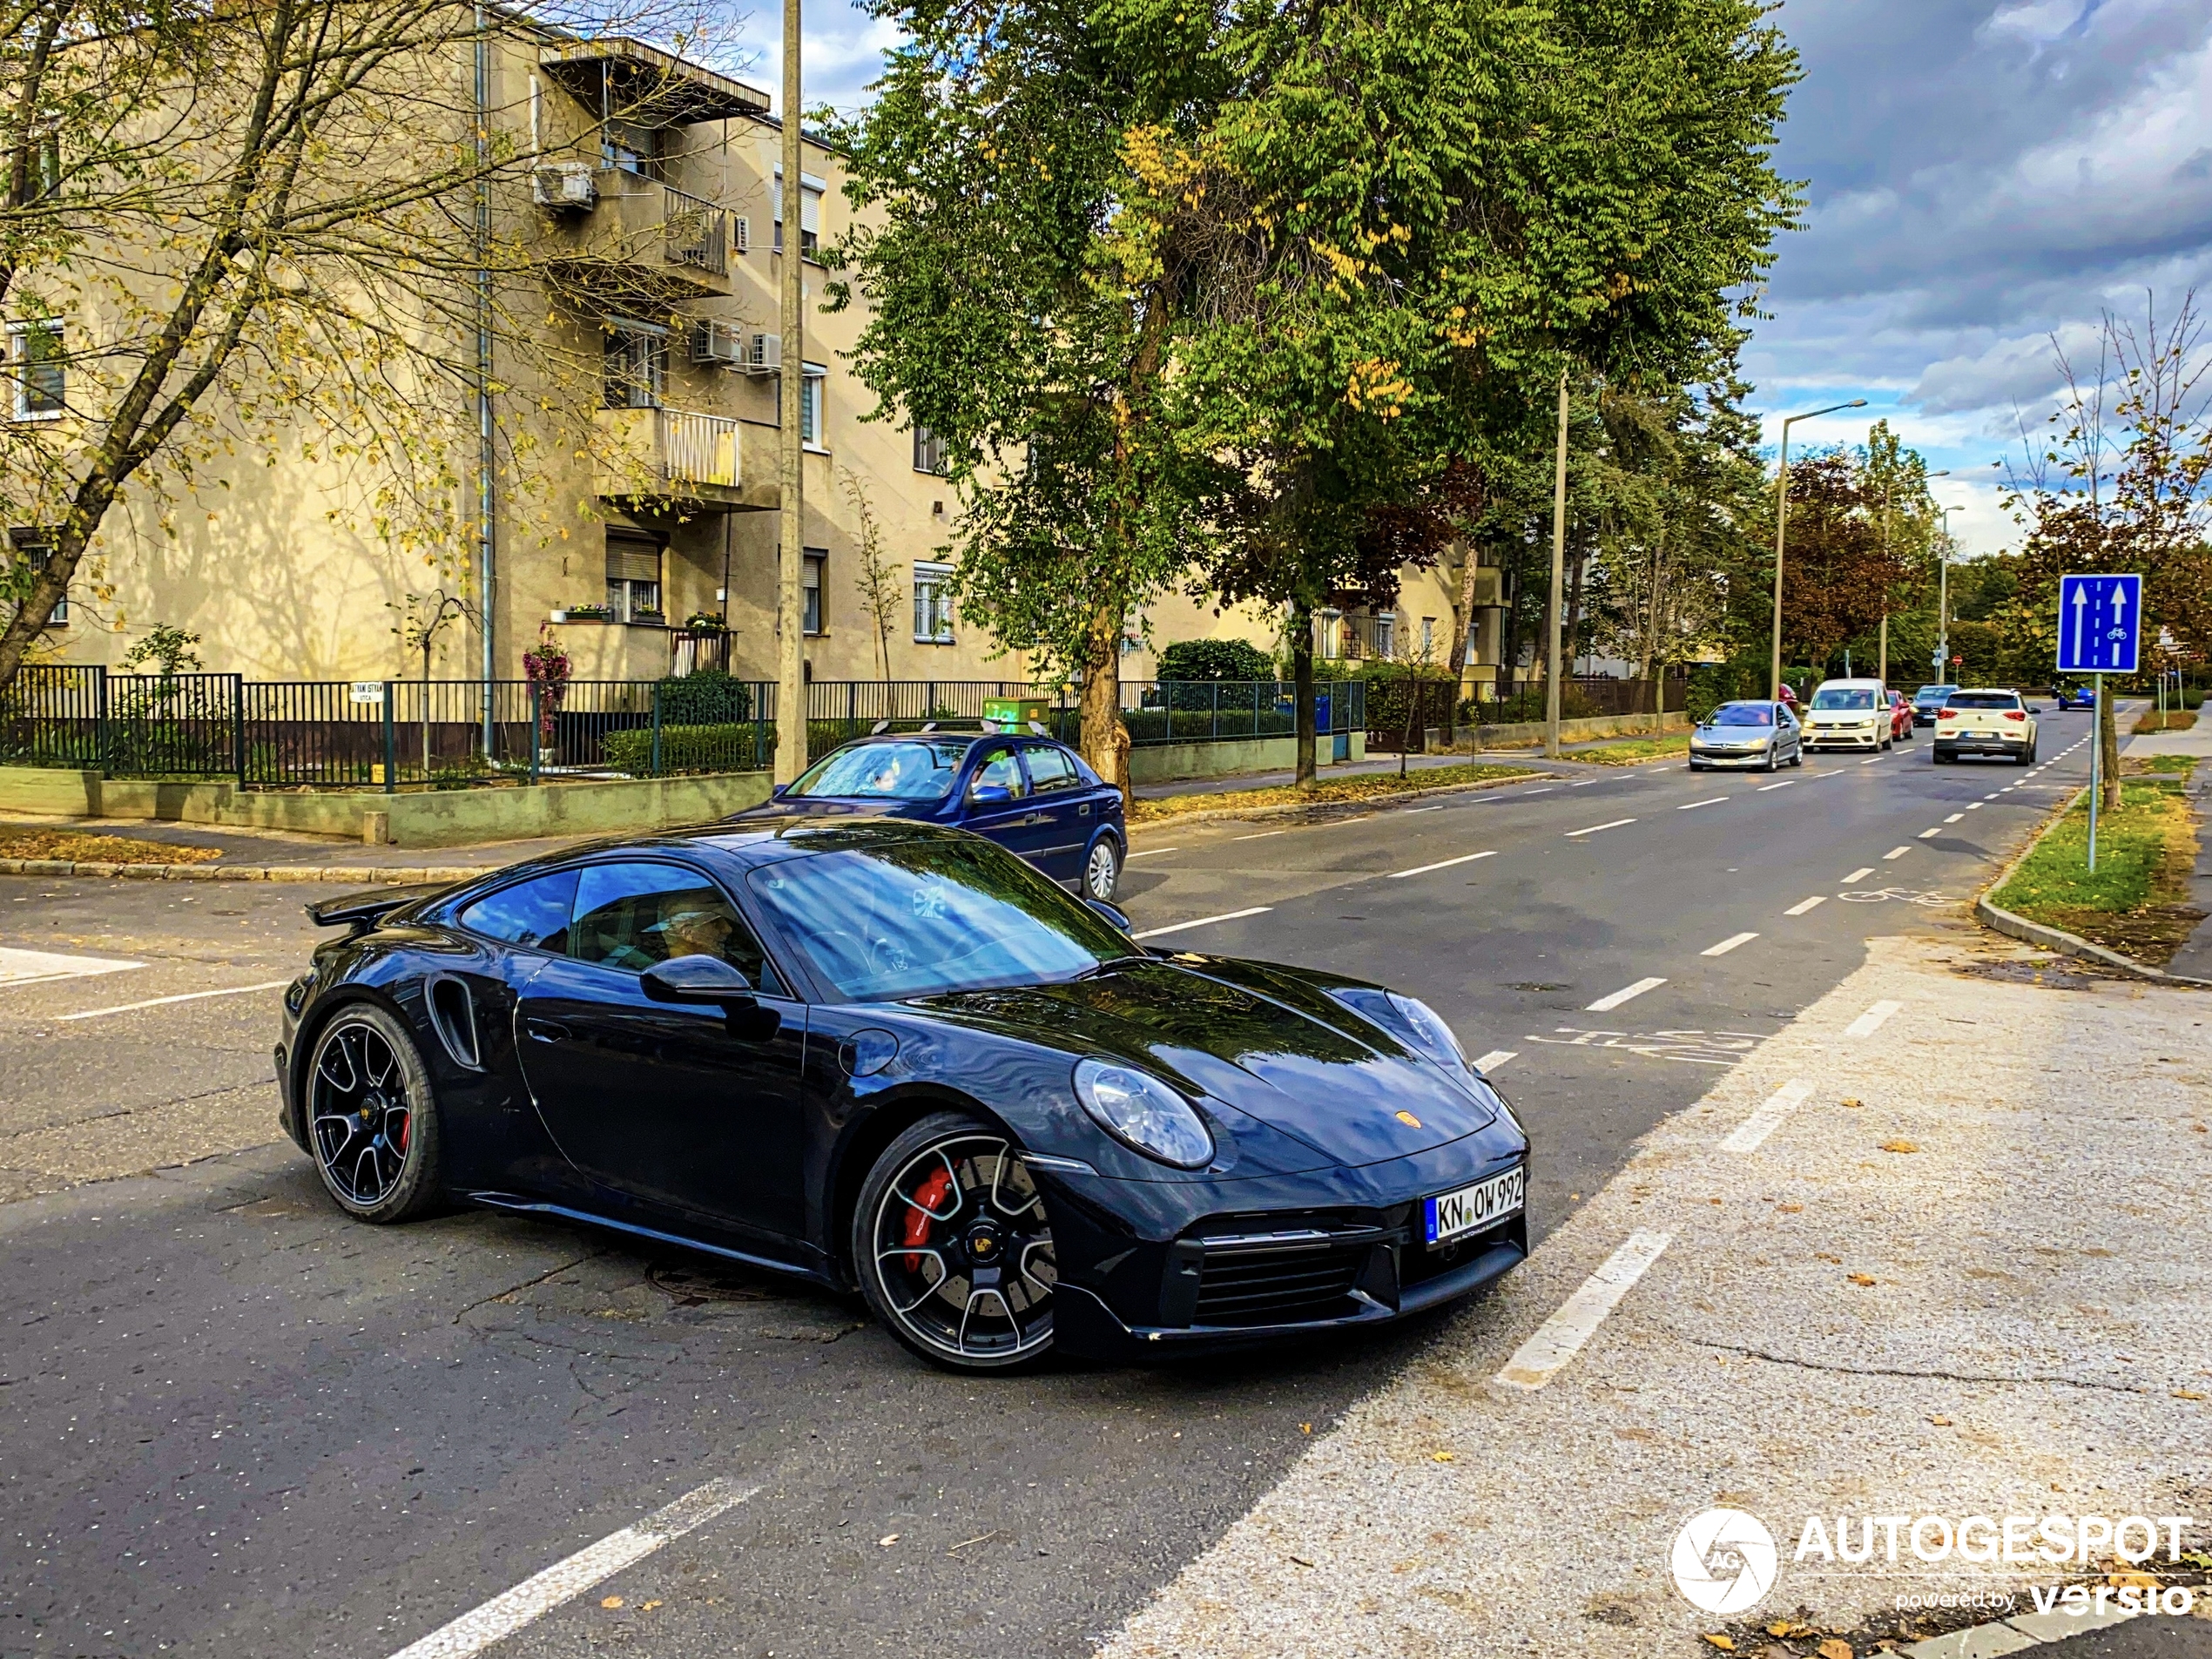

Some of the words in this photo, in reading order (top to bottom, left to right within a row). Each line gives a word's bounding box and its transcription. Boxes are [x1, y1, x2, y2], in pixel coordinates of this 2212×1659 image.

[1439, 1195, 1462, 1233] KN
[1474, 1184, 1494, 1219] OW
[1499, 1171, 1521, 1210] 992
